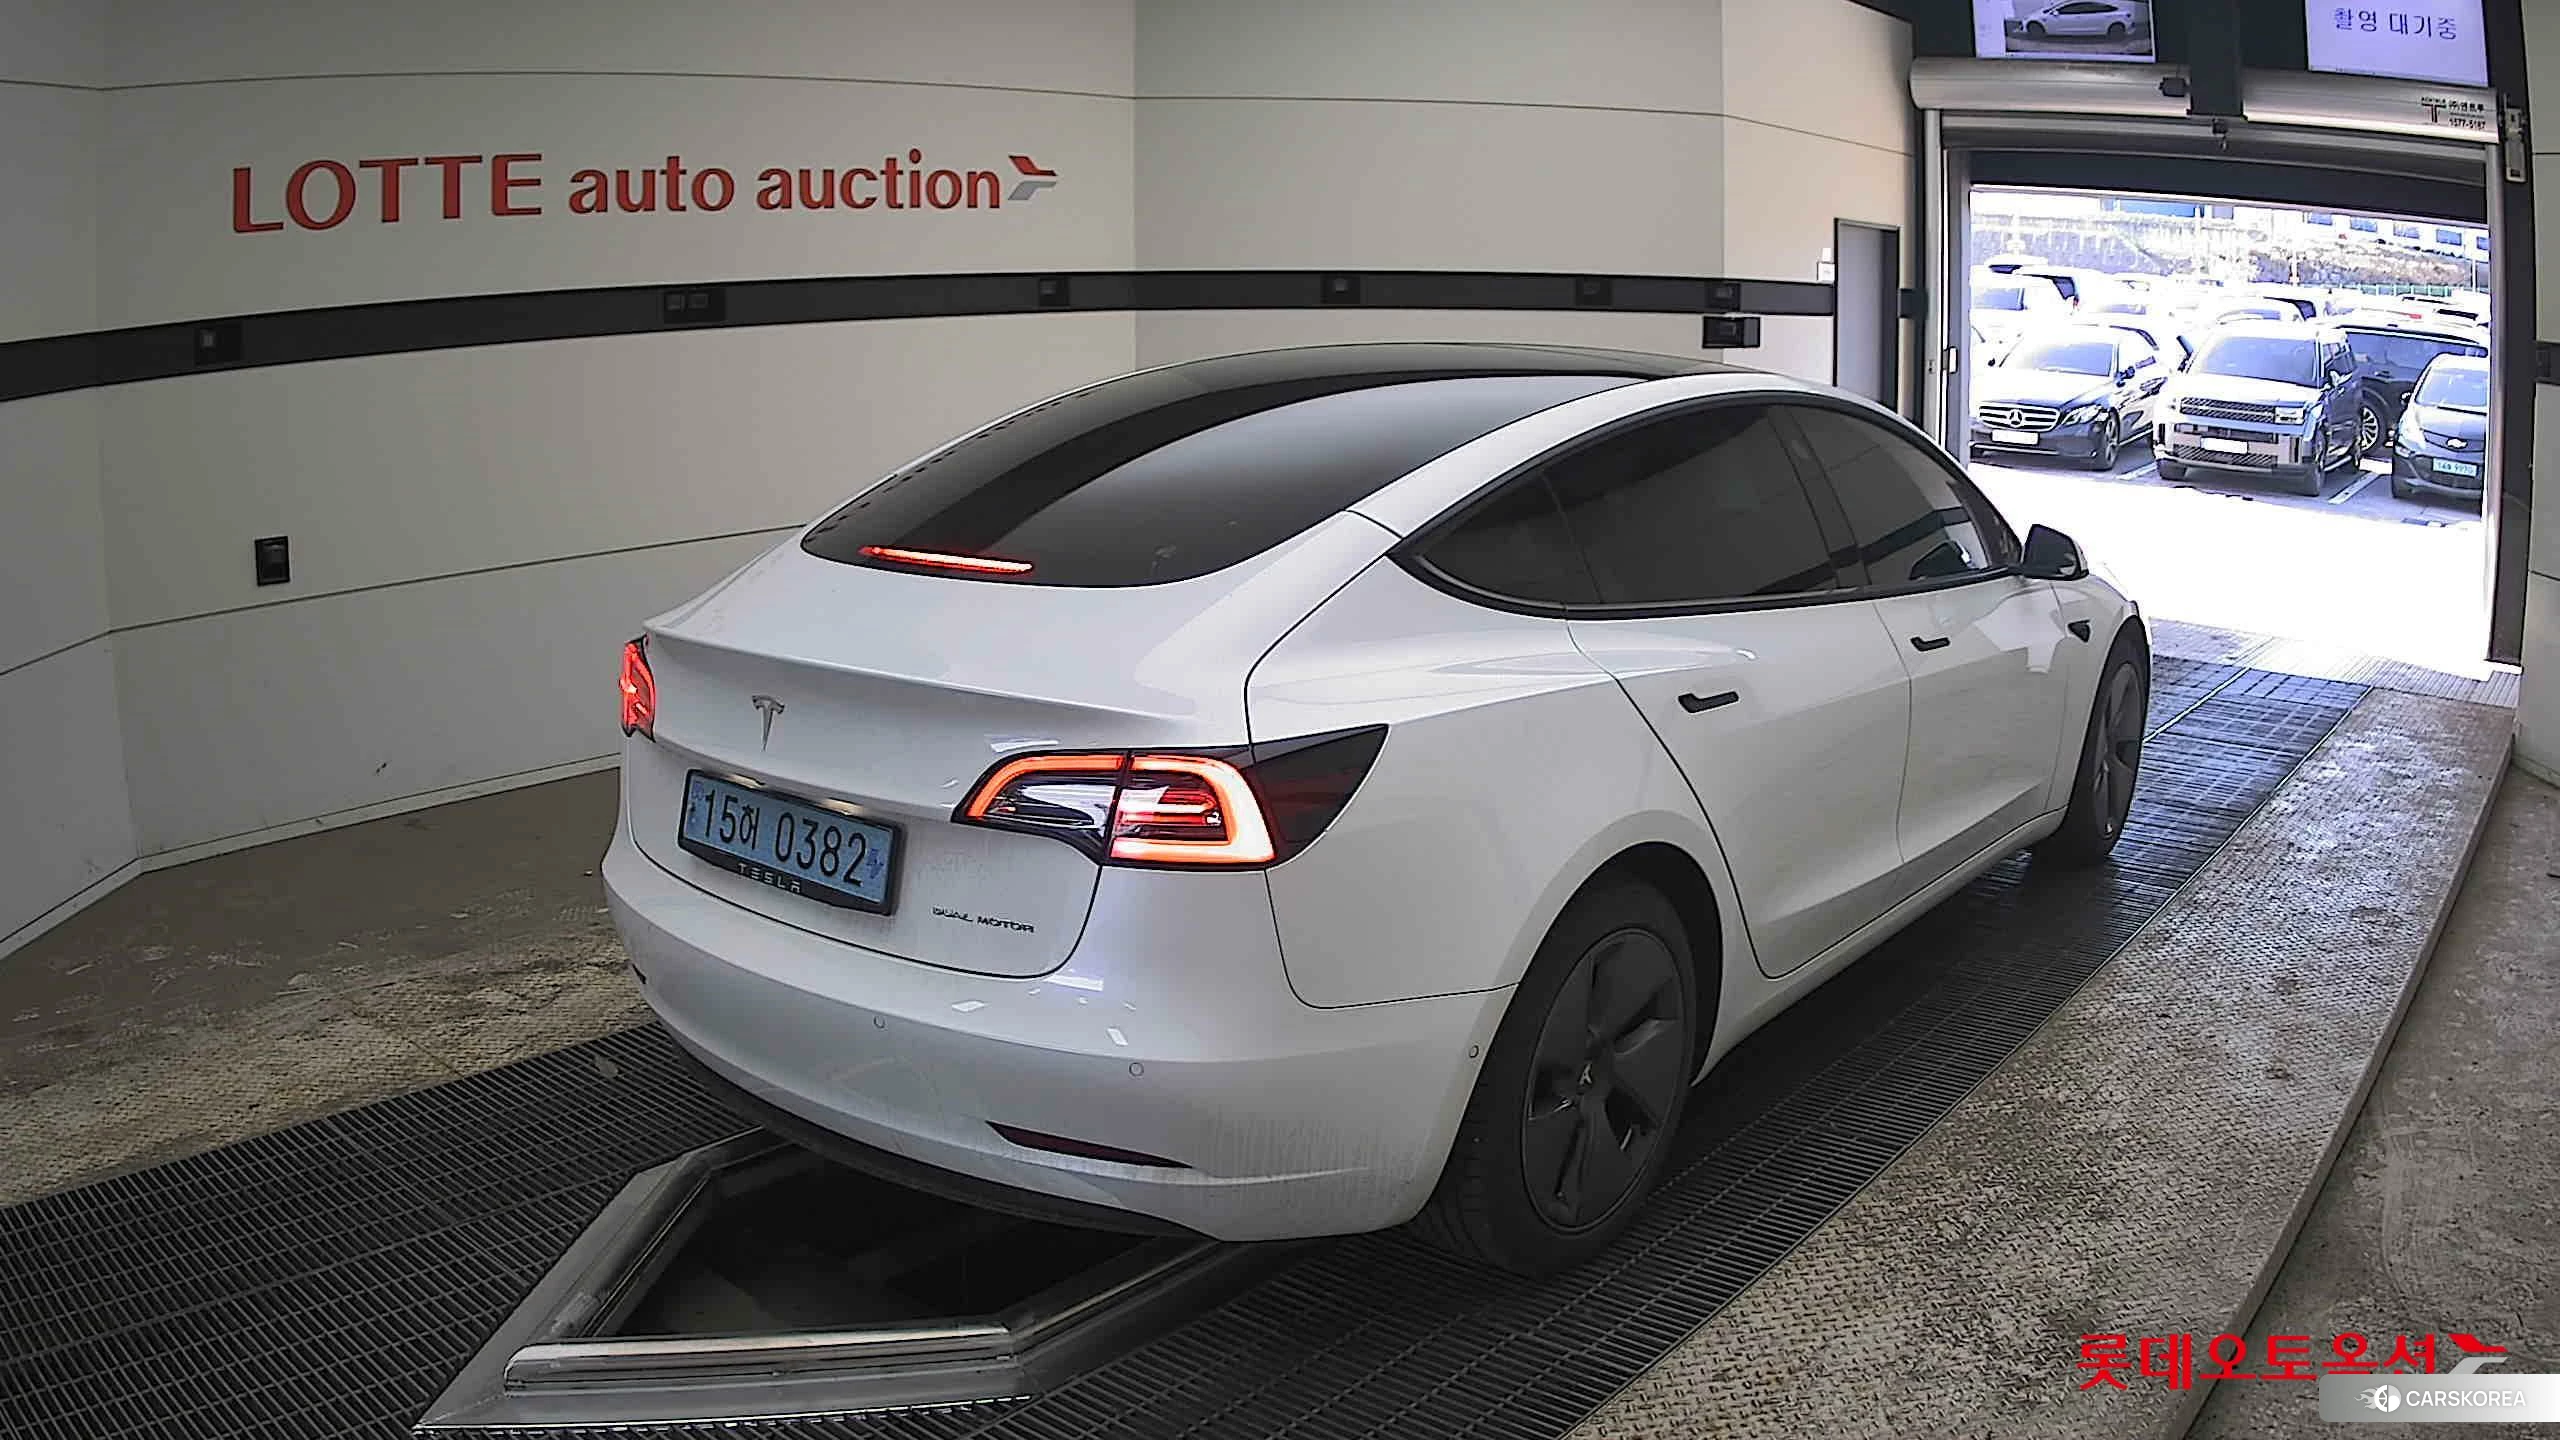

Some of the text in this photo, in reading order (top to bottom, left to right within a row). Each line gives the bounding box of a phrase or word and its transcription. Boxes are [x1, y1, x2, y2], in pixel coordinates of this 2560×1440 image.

[2335, 7, 2457, 40] 촬영 대기중
[232, 149, 1001, 233] LOTTE auto auction
[705, 789, 867, 887] 15허 0382
[738, 862, 801, 893] TESLA
[932, 906, 1034, 933] DUAL MOTOR
